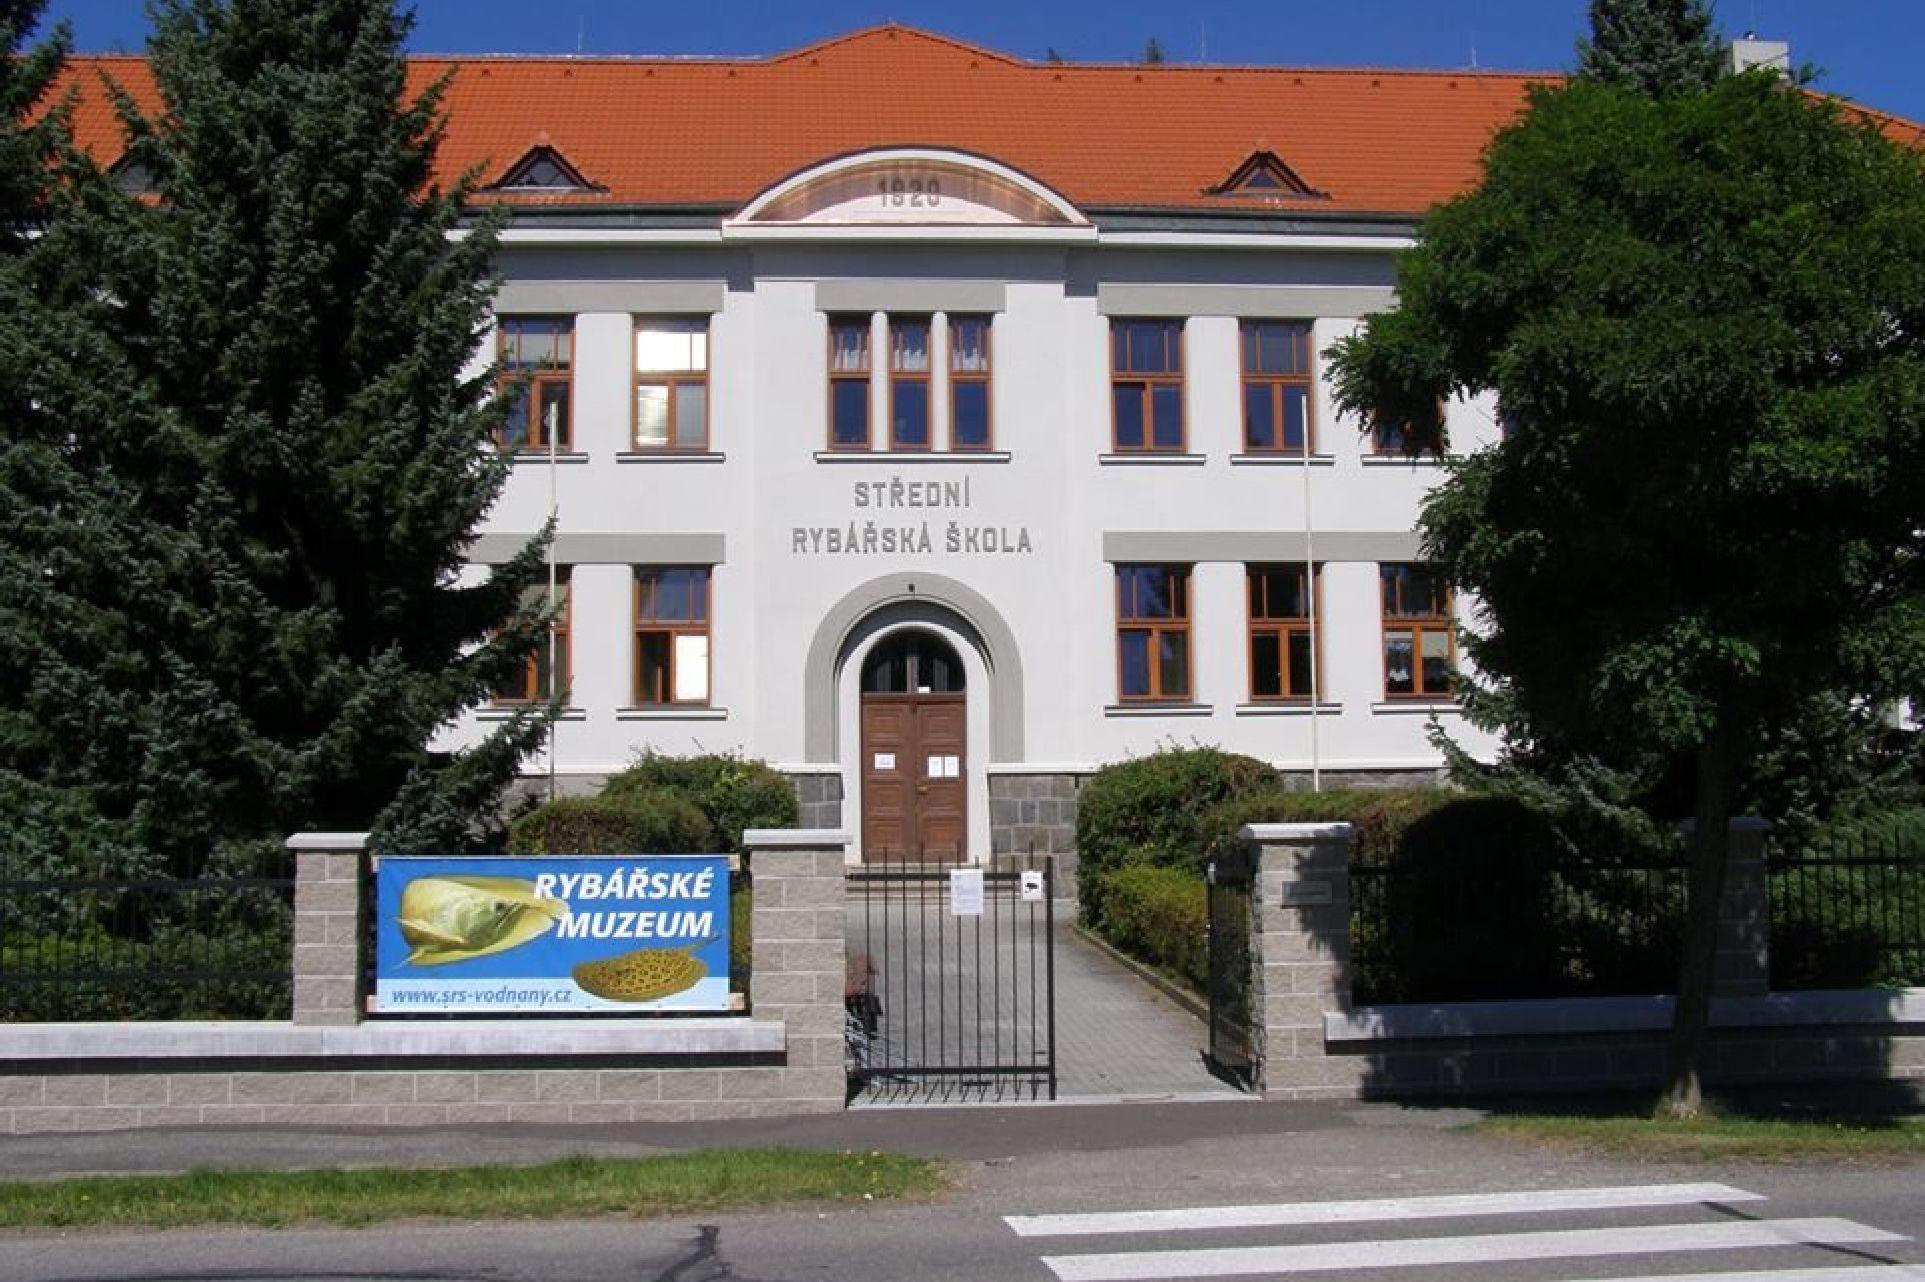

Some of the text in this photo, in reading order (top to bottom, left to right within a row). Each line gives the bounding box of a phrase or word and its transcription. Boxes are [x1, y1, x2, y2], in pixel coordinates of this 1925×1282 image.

[854, 475, 970, 507] STŘEDNÍ
[792, 522, 1033, 553] RYBÁŘSKÁ ŠKOLA
[534, 867, 712, 900] RYBÁŘSKÉ
[556, 911, 712, 938] MUZEUM
[392, 985, 572, 1006] www.srs-vodnany.cz
